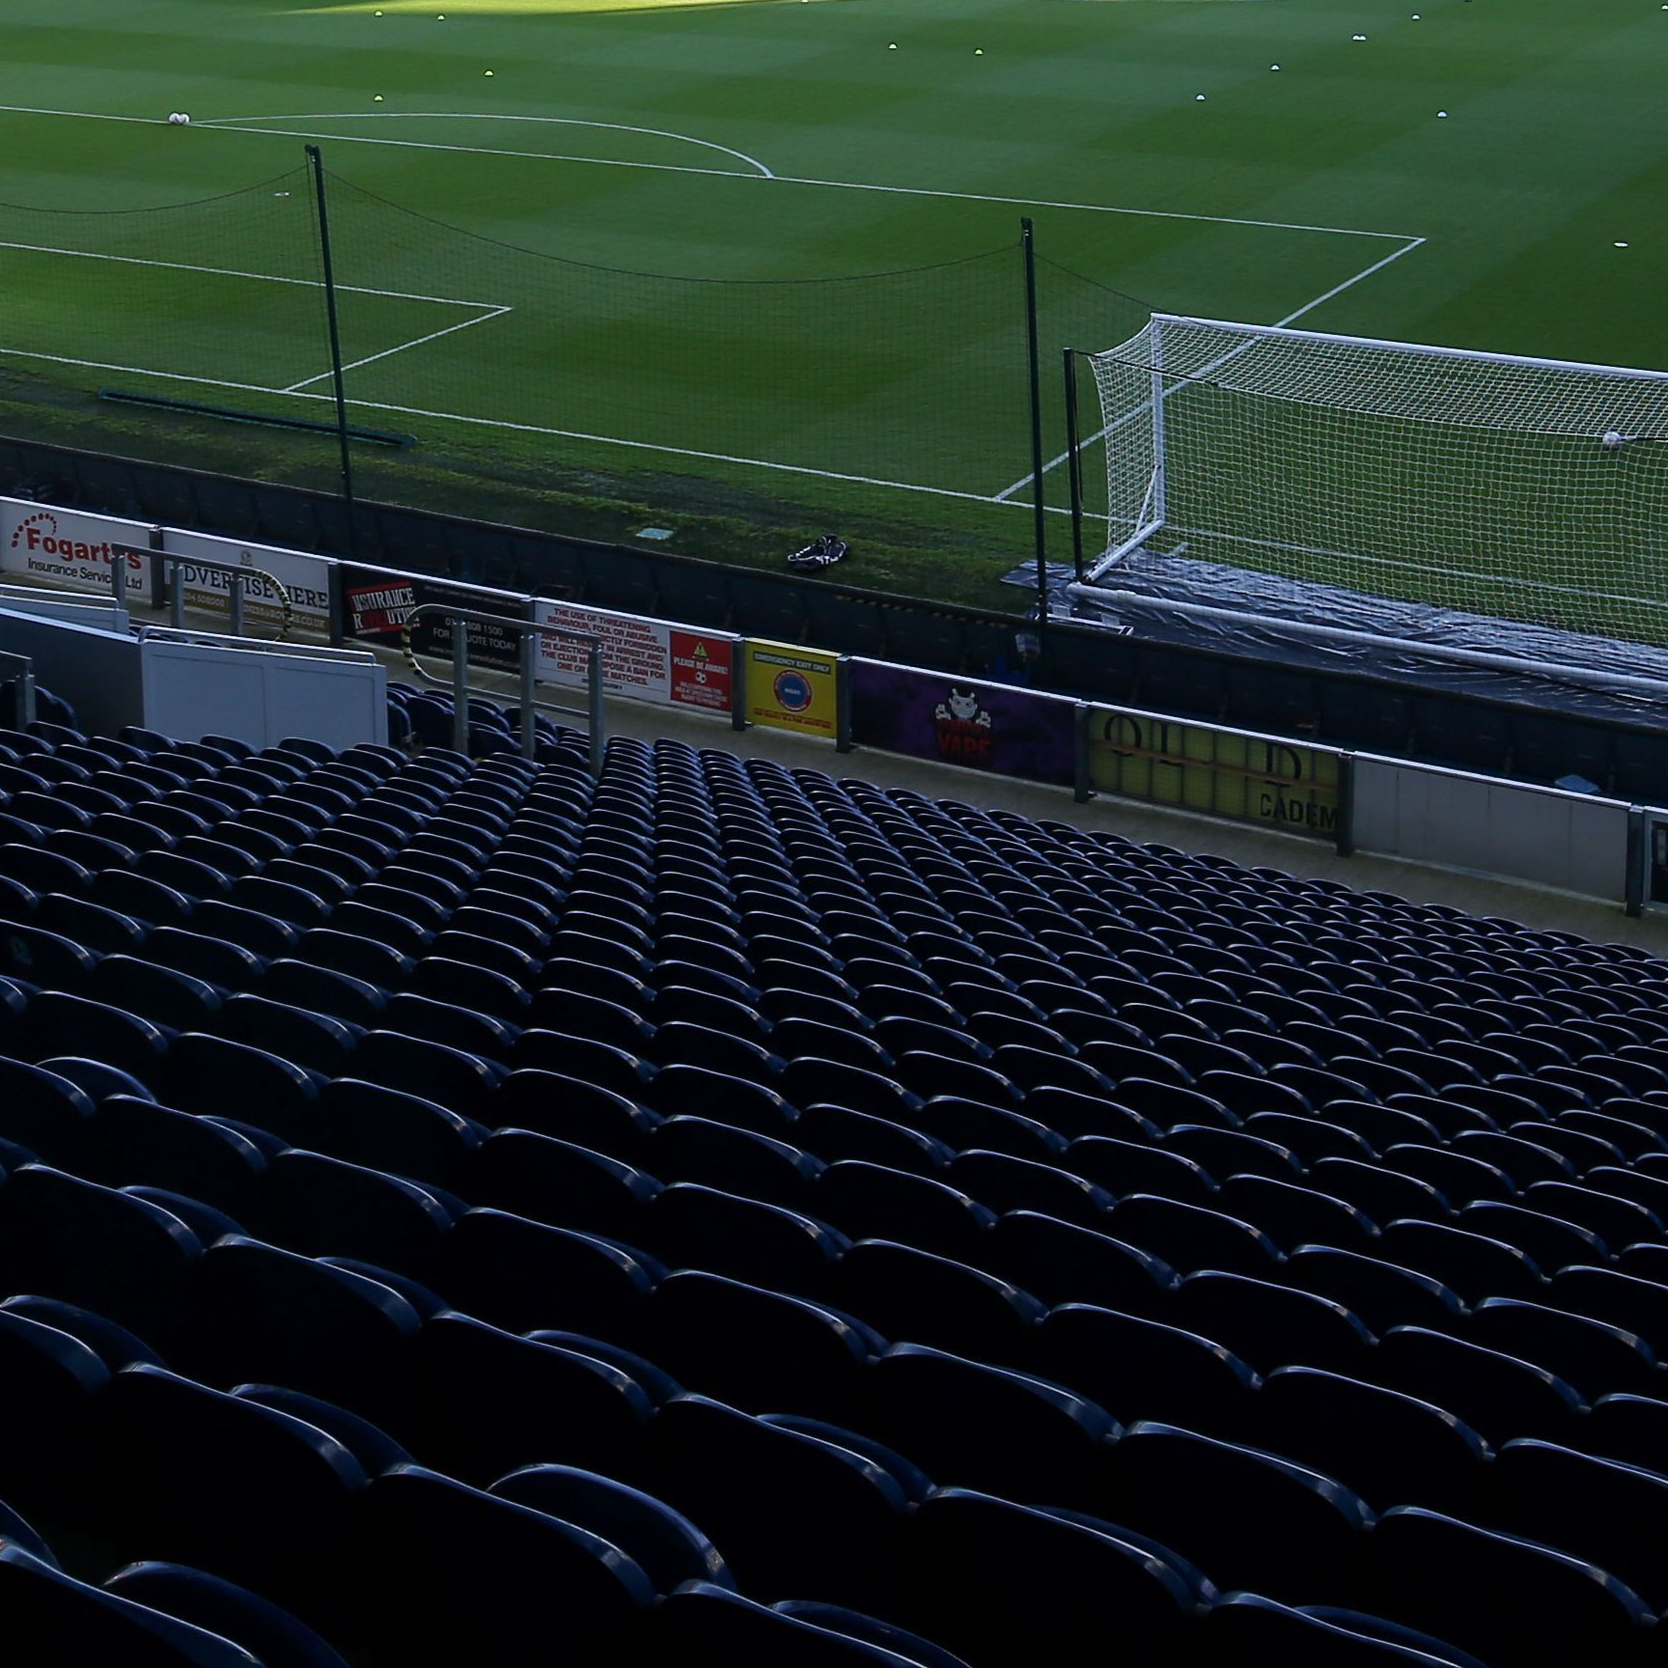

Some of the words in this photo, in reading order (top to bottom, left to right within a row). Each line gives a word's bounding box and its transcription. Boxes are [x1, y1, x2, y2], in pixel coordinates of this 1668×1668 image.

[27, 557, 78, 578] Insurance
[125, 575, 143, 589] Ltd
[554, 608, 570, 618] THE
[570, 611, 586, 621] USE
[587, 613, 598, 623] OF
[599, 616, 651, 634] THREATENING
[433, 627, 450, 639] FOR
[489, 635, 517, 652] TODAY
[592, 623, 612, 635] FOUL
[613, 627, 625, 637] OR
[626, 630, 658, 643] ABUSIVE
[540, 641, 552, 650] OR
[615, 654, 631, 664] THE
[616, 647, 645, 658] ARREST
[646, 651, 662, 662] AND
[623, 640, 667, 654] FORBIDDEN
[541, 650, 557, 660] THE
[557, 653, 578, 664] CLUB
[633, 666, 650, 678] BAN
[650, 669, 666, 680] FOR
[556, 662, 573, 671] ONE
[574, 665, 586, 673] OR
[673, 656, 695, 668] PLEASE
[754, 652, 796, 666] EMERGENCY
[796, 659, 812, 670] EXIT
[813, 663, 830, 673] ONLY
